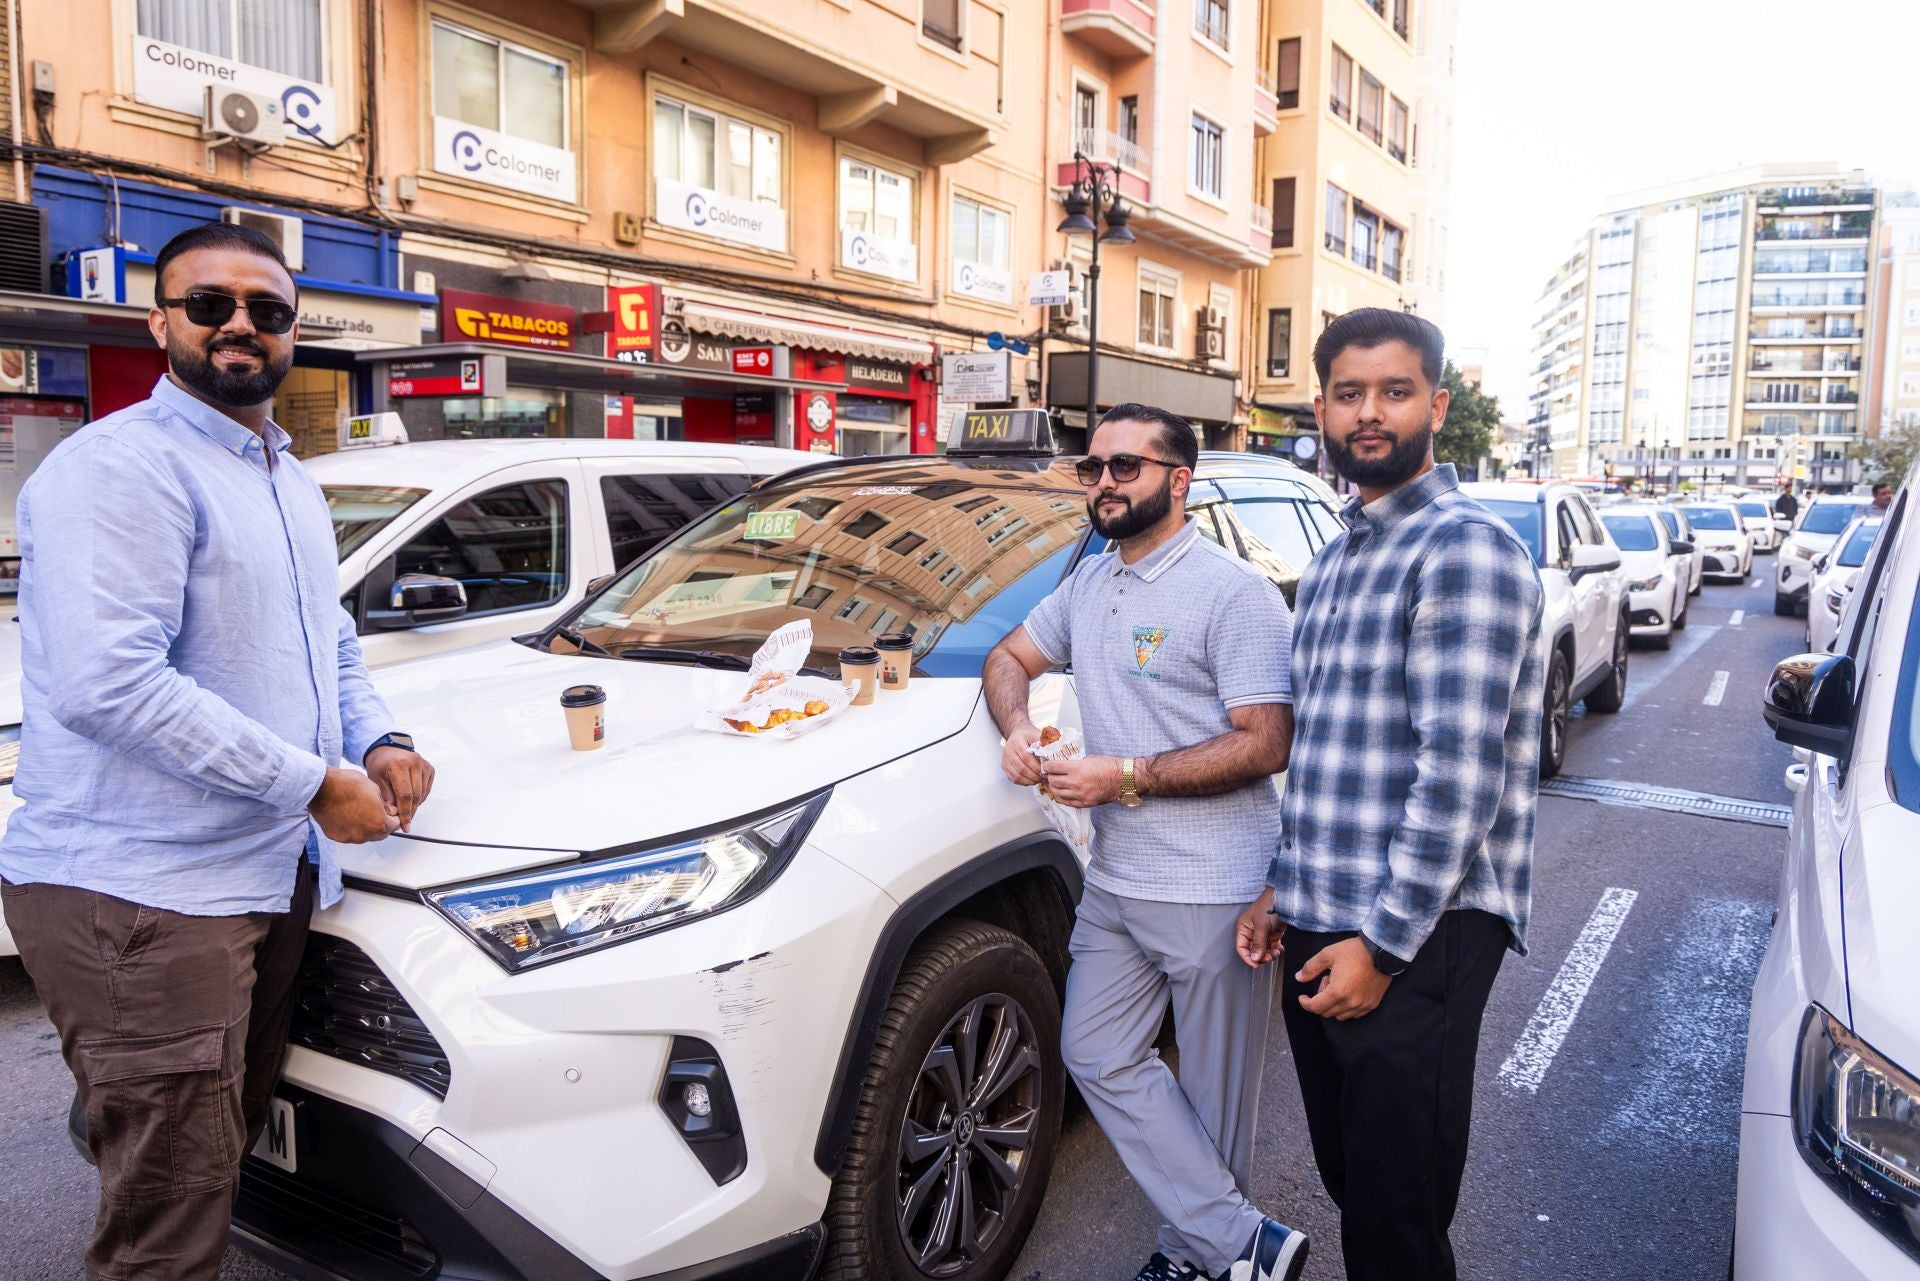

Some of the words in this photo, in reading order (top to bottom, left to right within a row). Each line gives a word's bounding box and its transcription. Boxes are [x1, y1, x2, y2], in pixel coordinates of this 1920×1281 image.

[146, 44, 237, 81] Colomer
[485, 149, 560, 182] Colomer
[709, 206, 762, 232] Colomer
[488, 312, 568, 336] TABACOS
[617, 336, 651, 346] TABACOS
[697, 343, 723, 362] SAN
[852, 365, 903, 384] HELADERIA
[968, 415, 1009, 439] TAXI
[751, 515, 793, 534] LIBRE
